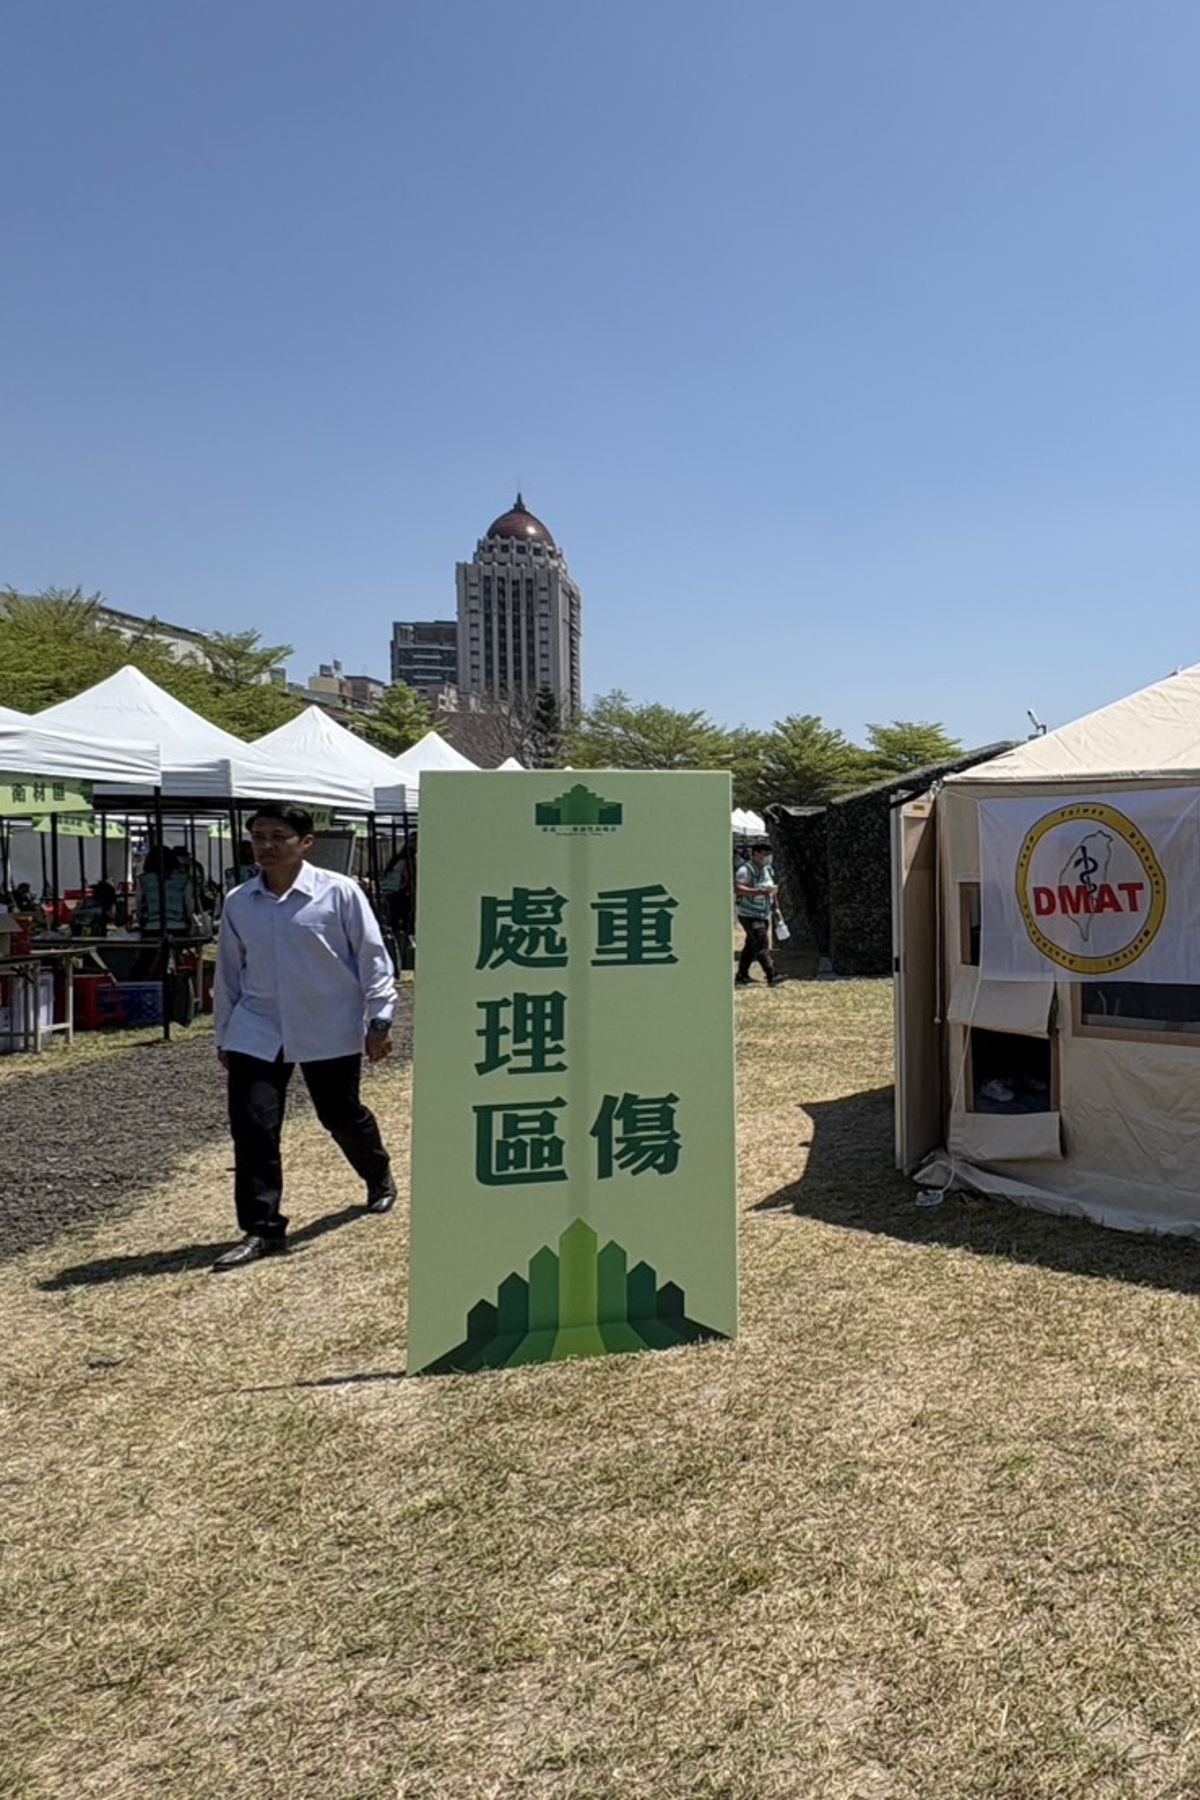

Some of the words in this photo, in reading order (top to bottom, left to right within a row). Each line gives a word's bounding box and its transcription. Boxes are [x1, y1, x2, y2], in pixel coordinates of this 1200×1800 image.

[11, 781, 66, 803] 衛材區
[1033, 882, 1144, 916] DMAT
[472, 886, 569, 1187] 處理區
[589, 884, 683, 1181] 重傷
